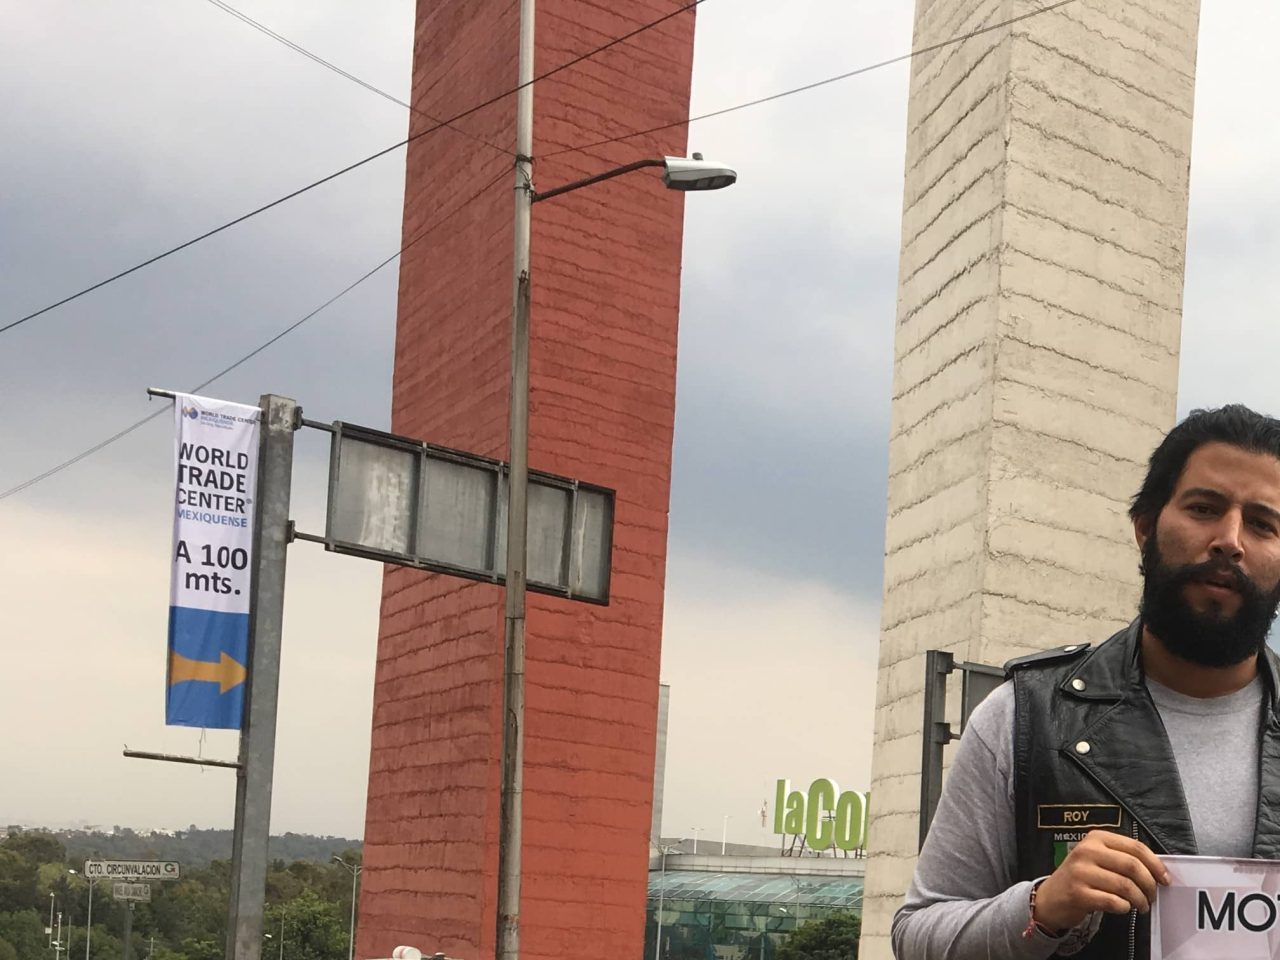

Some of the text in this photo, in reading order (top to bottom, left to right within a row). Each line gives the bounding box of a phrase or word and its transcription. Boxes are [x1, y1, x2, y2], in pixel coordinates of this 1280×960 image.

[180, 442, 249, 470] WORLD
[178, 463, 246, 493] TRADE
[178, 509, 248, 528] MEXIQUENSE
[176, 540, 248, 570] A 100
[185, 571, 241, 595] mts.
[774, 778, 871, 851] laCo
[1063, 810, 1090, 823] ROY
